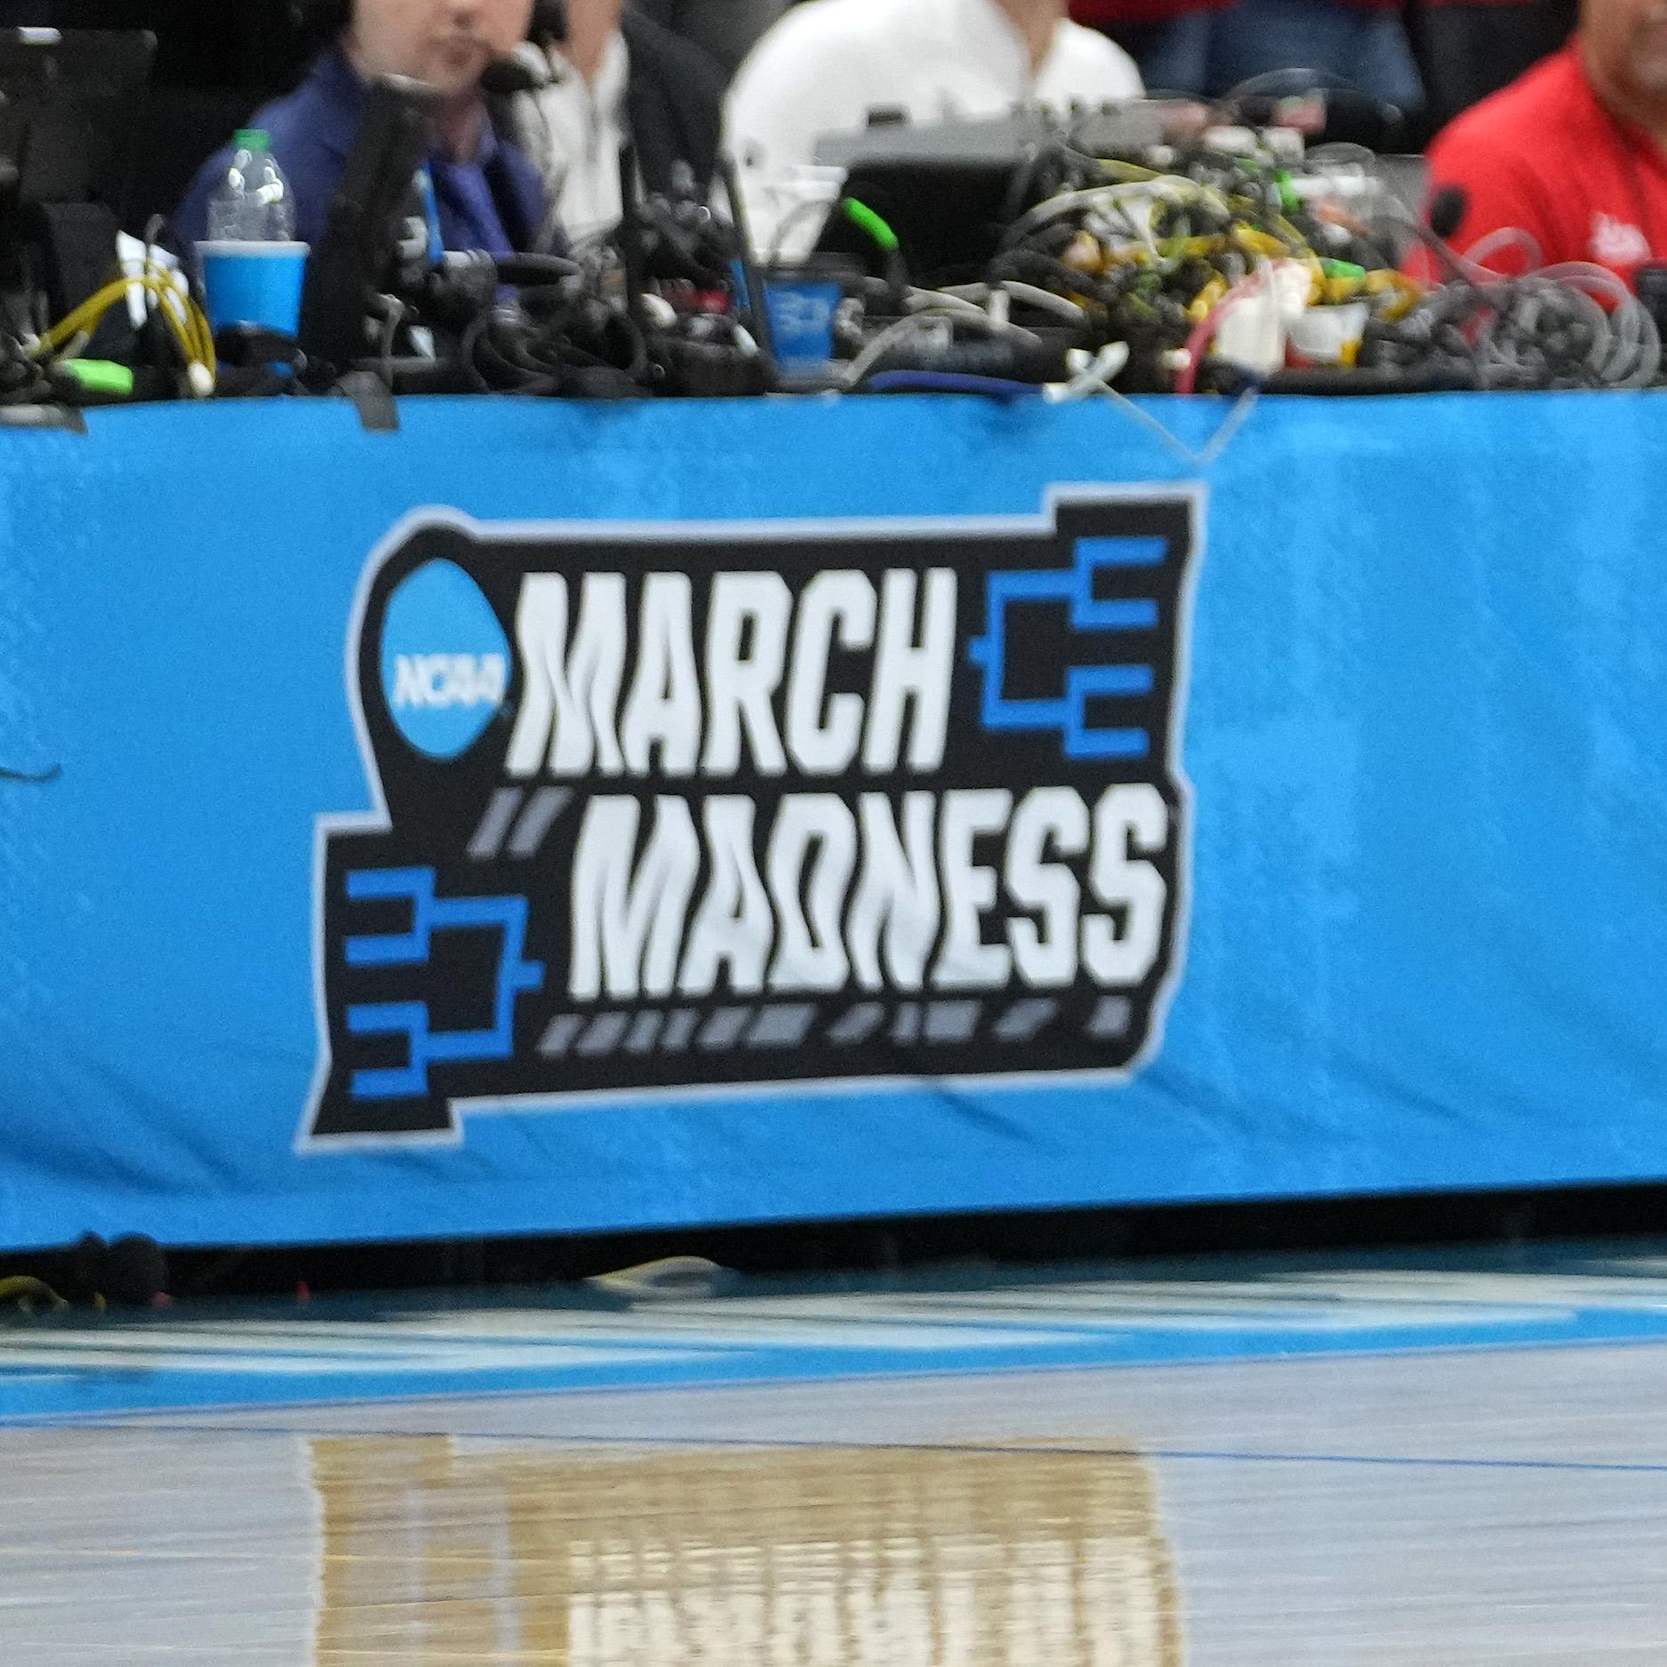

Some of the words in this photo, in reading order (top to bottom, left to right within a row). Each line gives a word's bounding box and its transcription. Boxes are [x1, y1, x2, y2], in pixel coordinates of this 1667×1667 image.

[393, 653, 506, 707] NCAA
[507, 566, 957, 777] MARCH
[569, 783, 1168, 1002] MADNESS
